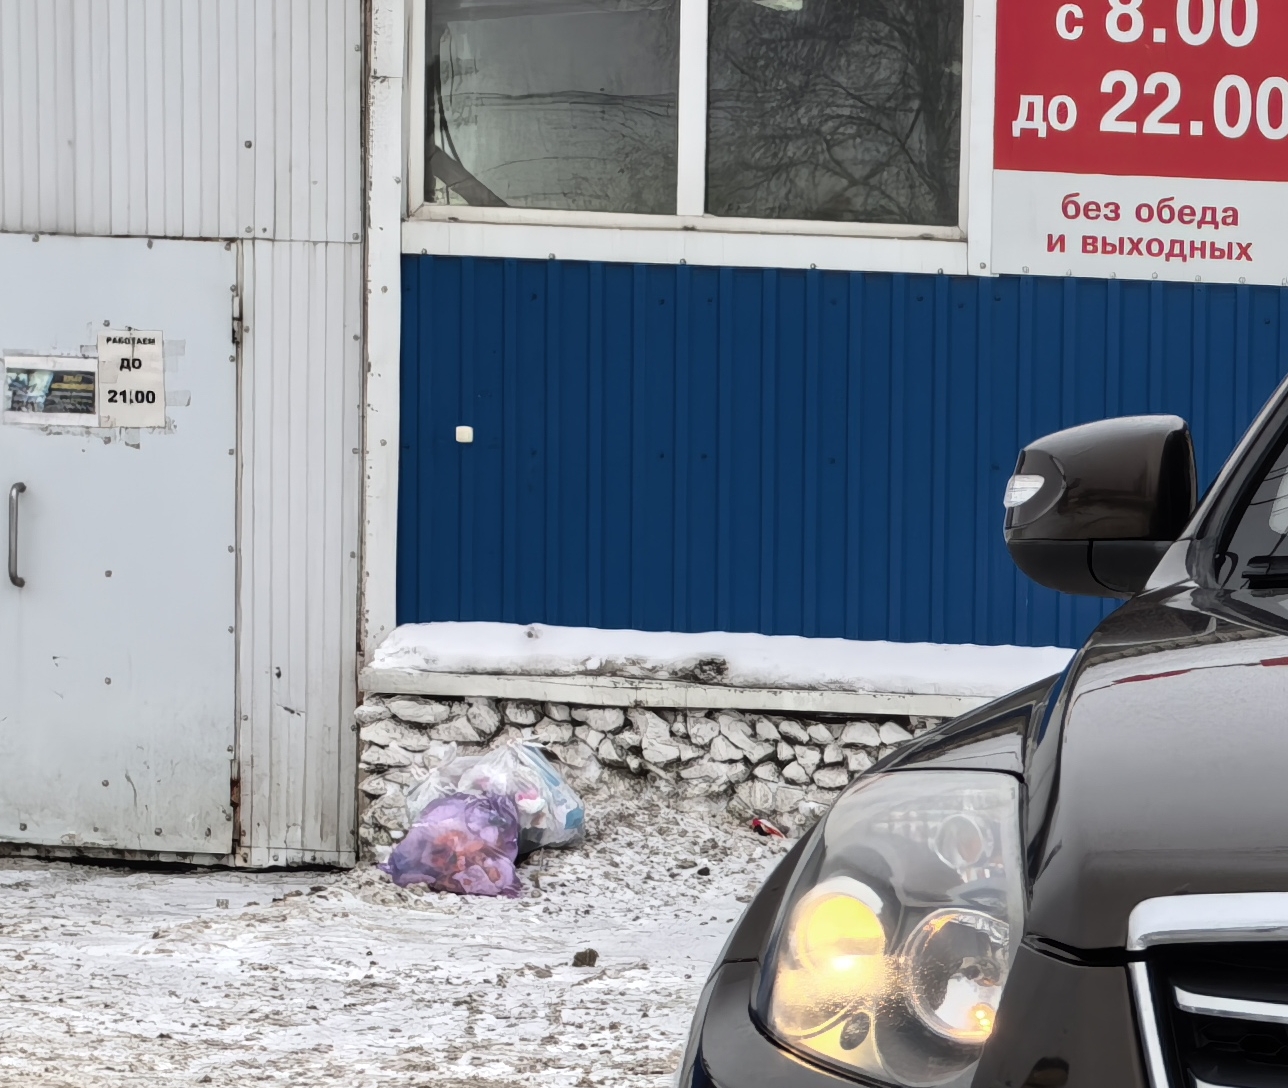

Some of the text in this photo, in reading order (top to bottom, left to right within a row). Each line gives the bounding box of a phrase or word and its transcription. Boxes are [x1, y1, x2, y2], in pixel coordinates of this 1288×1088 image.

[1055, 0, 1259, 47] с 8.00
[1012, 94, 1077, 138] до
[1061, 192, 1239, 230] без обеда
[1046, 233, 1253, 262] и выходных
[119, 358, 142, 371] ДО
